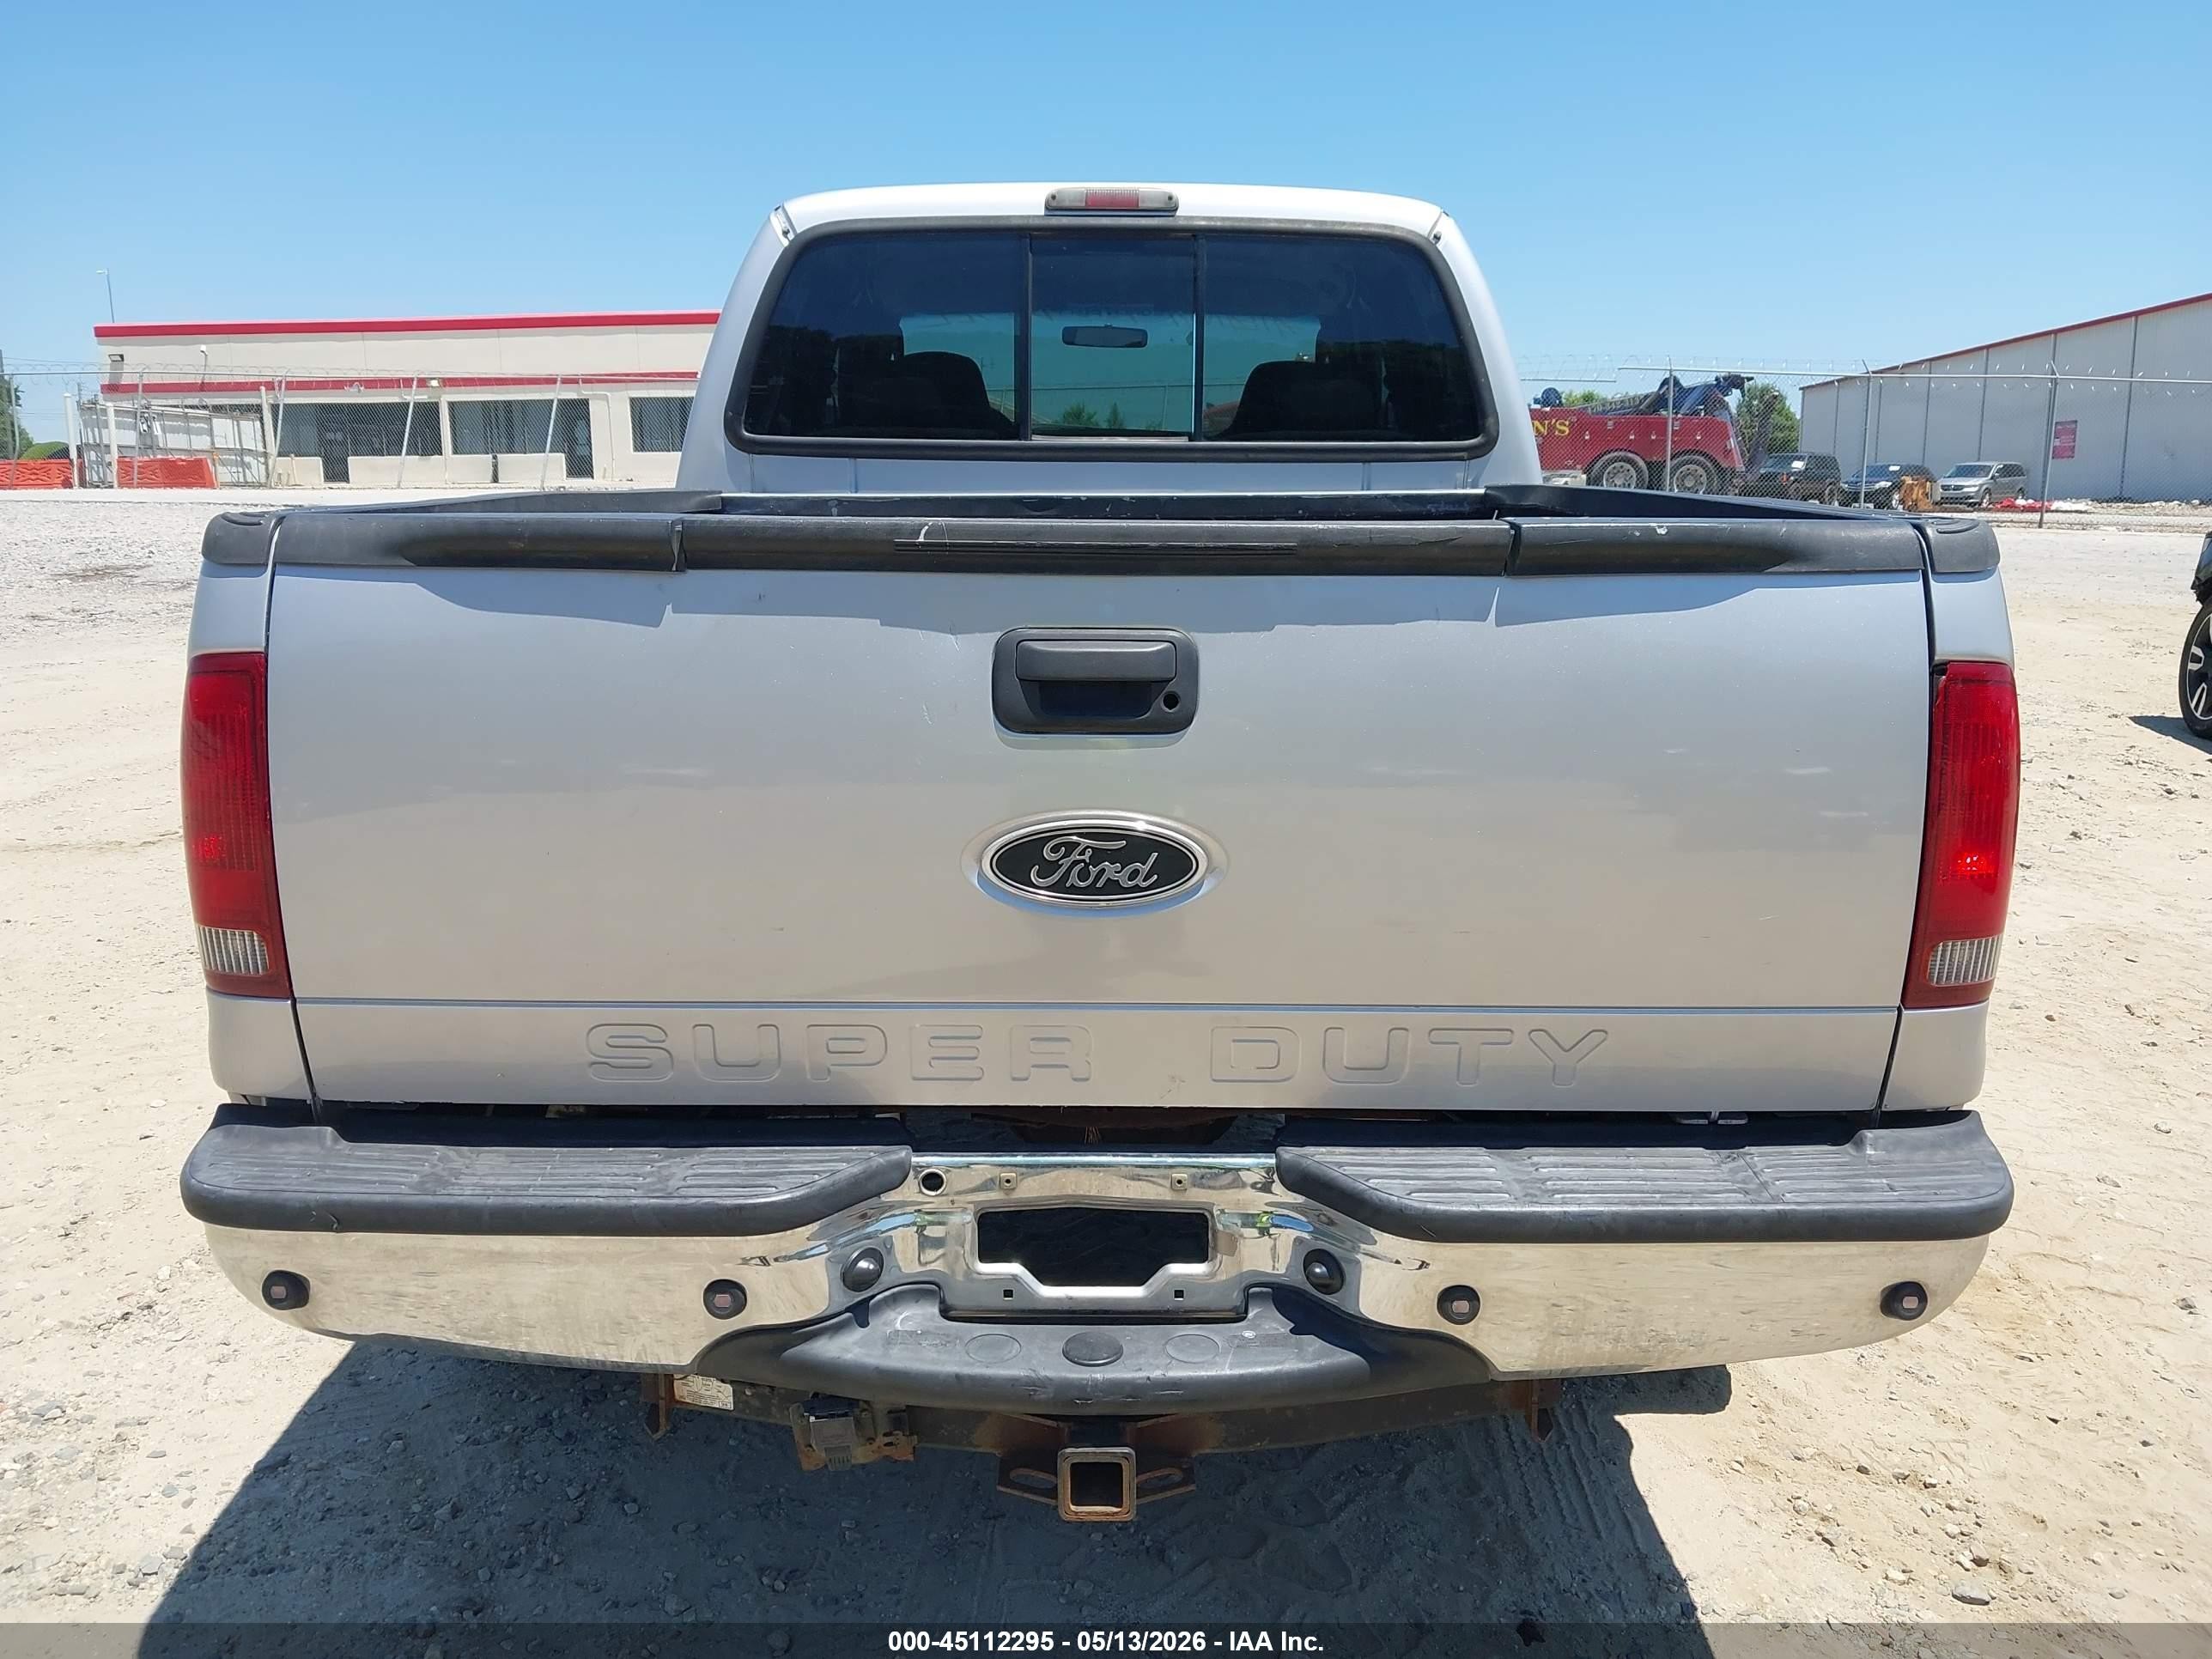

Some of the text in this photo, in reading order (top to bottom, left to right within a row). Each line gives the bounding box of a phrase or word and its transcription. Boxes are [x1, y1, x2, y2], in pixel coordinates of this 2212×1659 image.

[1031, 836, 1159, 888] Ford
[585, 1023, 1608, 1086] SUPER DUTY
